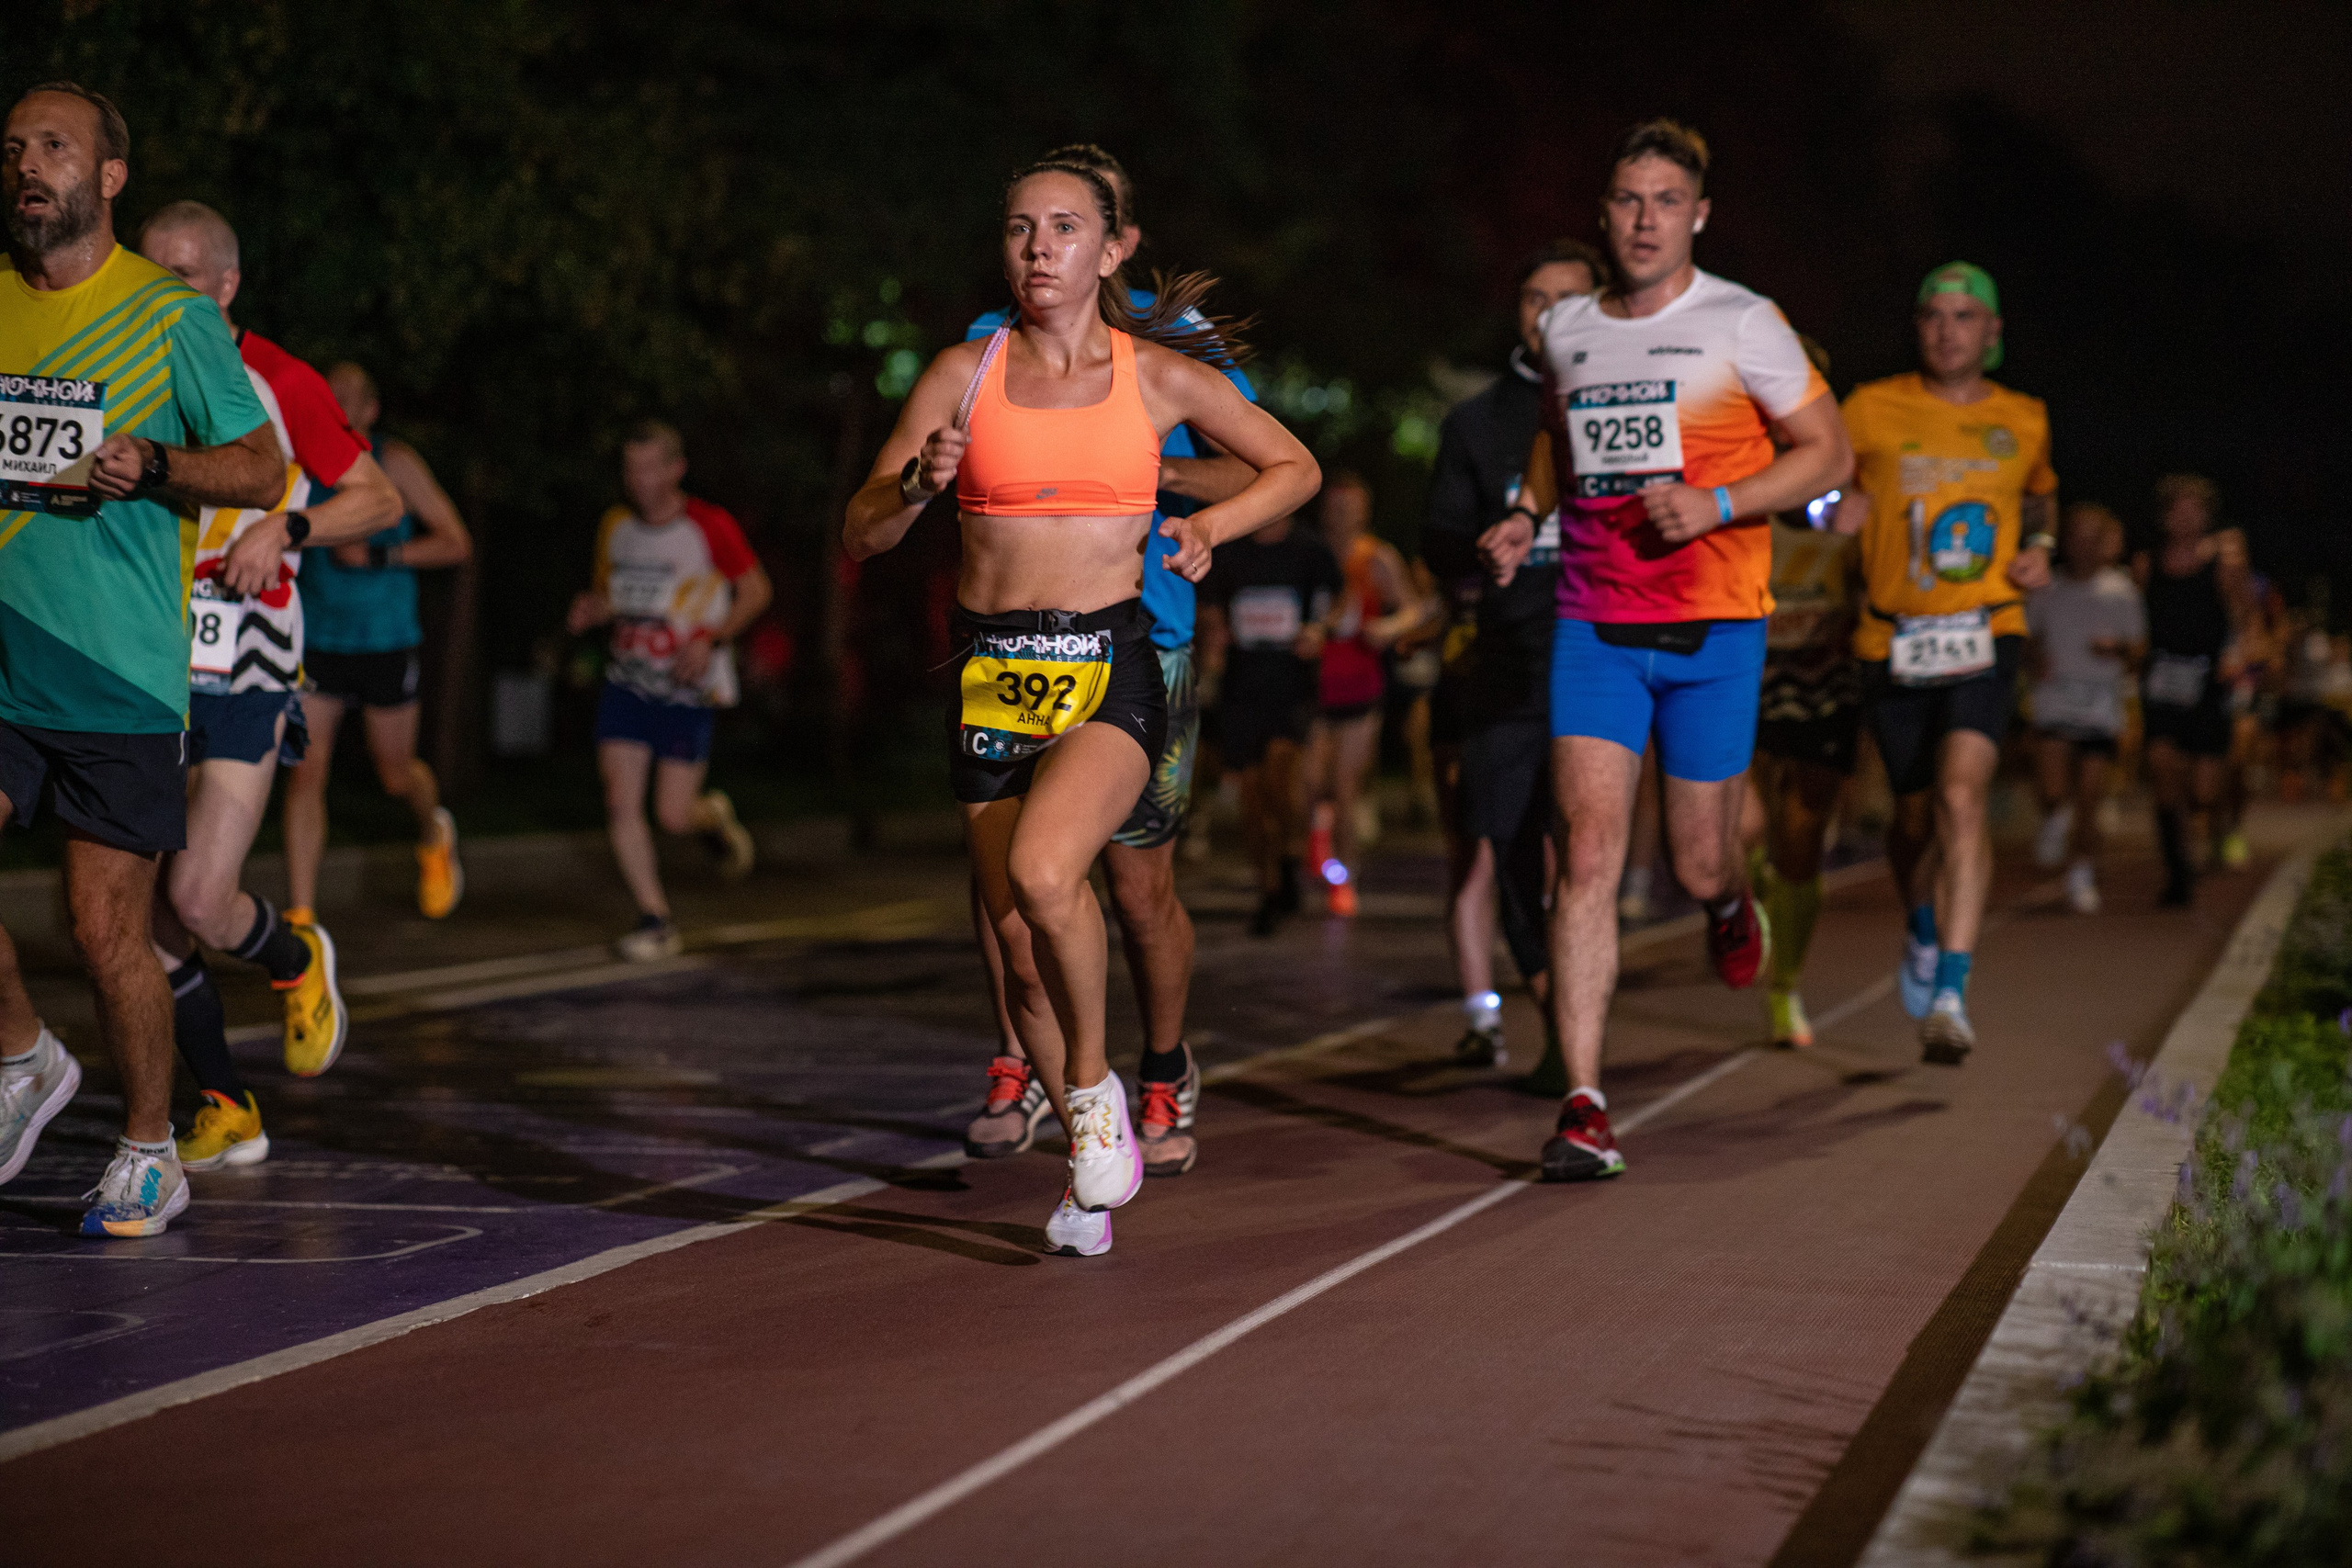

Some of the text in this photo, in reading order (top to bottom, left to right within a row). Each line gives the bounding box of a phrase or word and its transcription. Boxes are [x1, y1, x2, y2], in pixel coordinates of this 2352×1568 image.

[0, 413, 84, 460] 873
[1584, 415, 1664, 453] 9258
[3, 458, 57, 475] МИХАИЛ
[192, 612, 220, 645] 8
[996, 671, 1076, 712] 392
